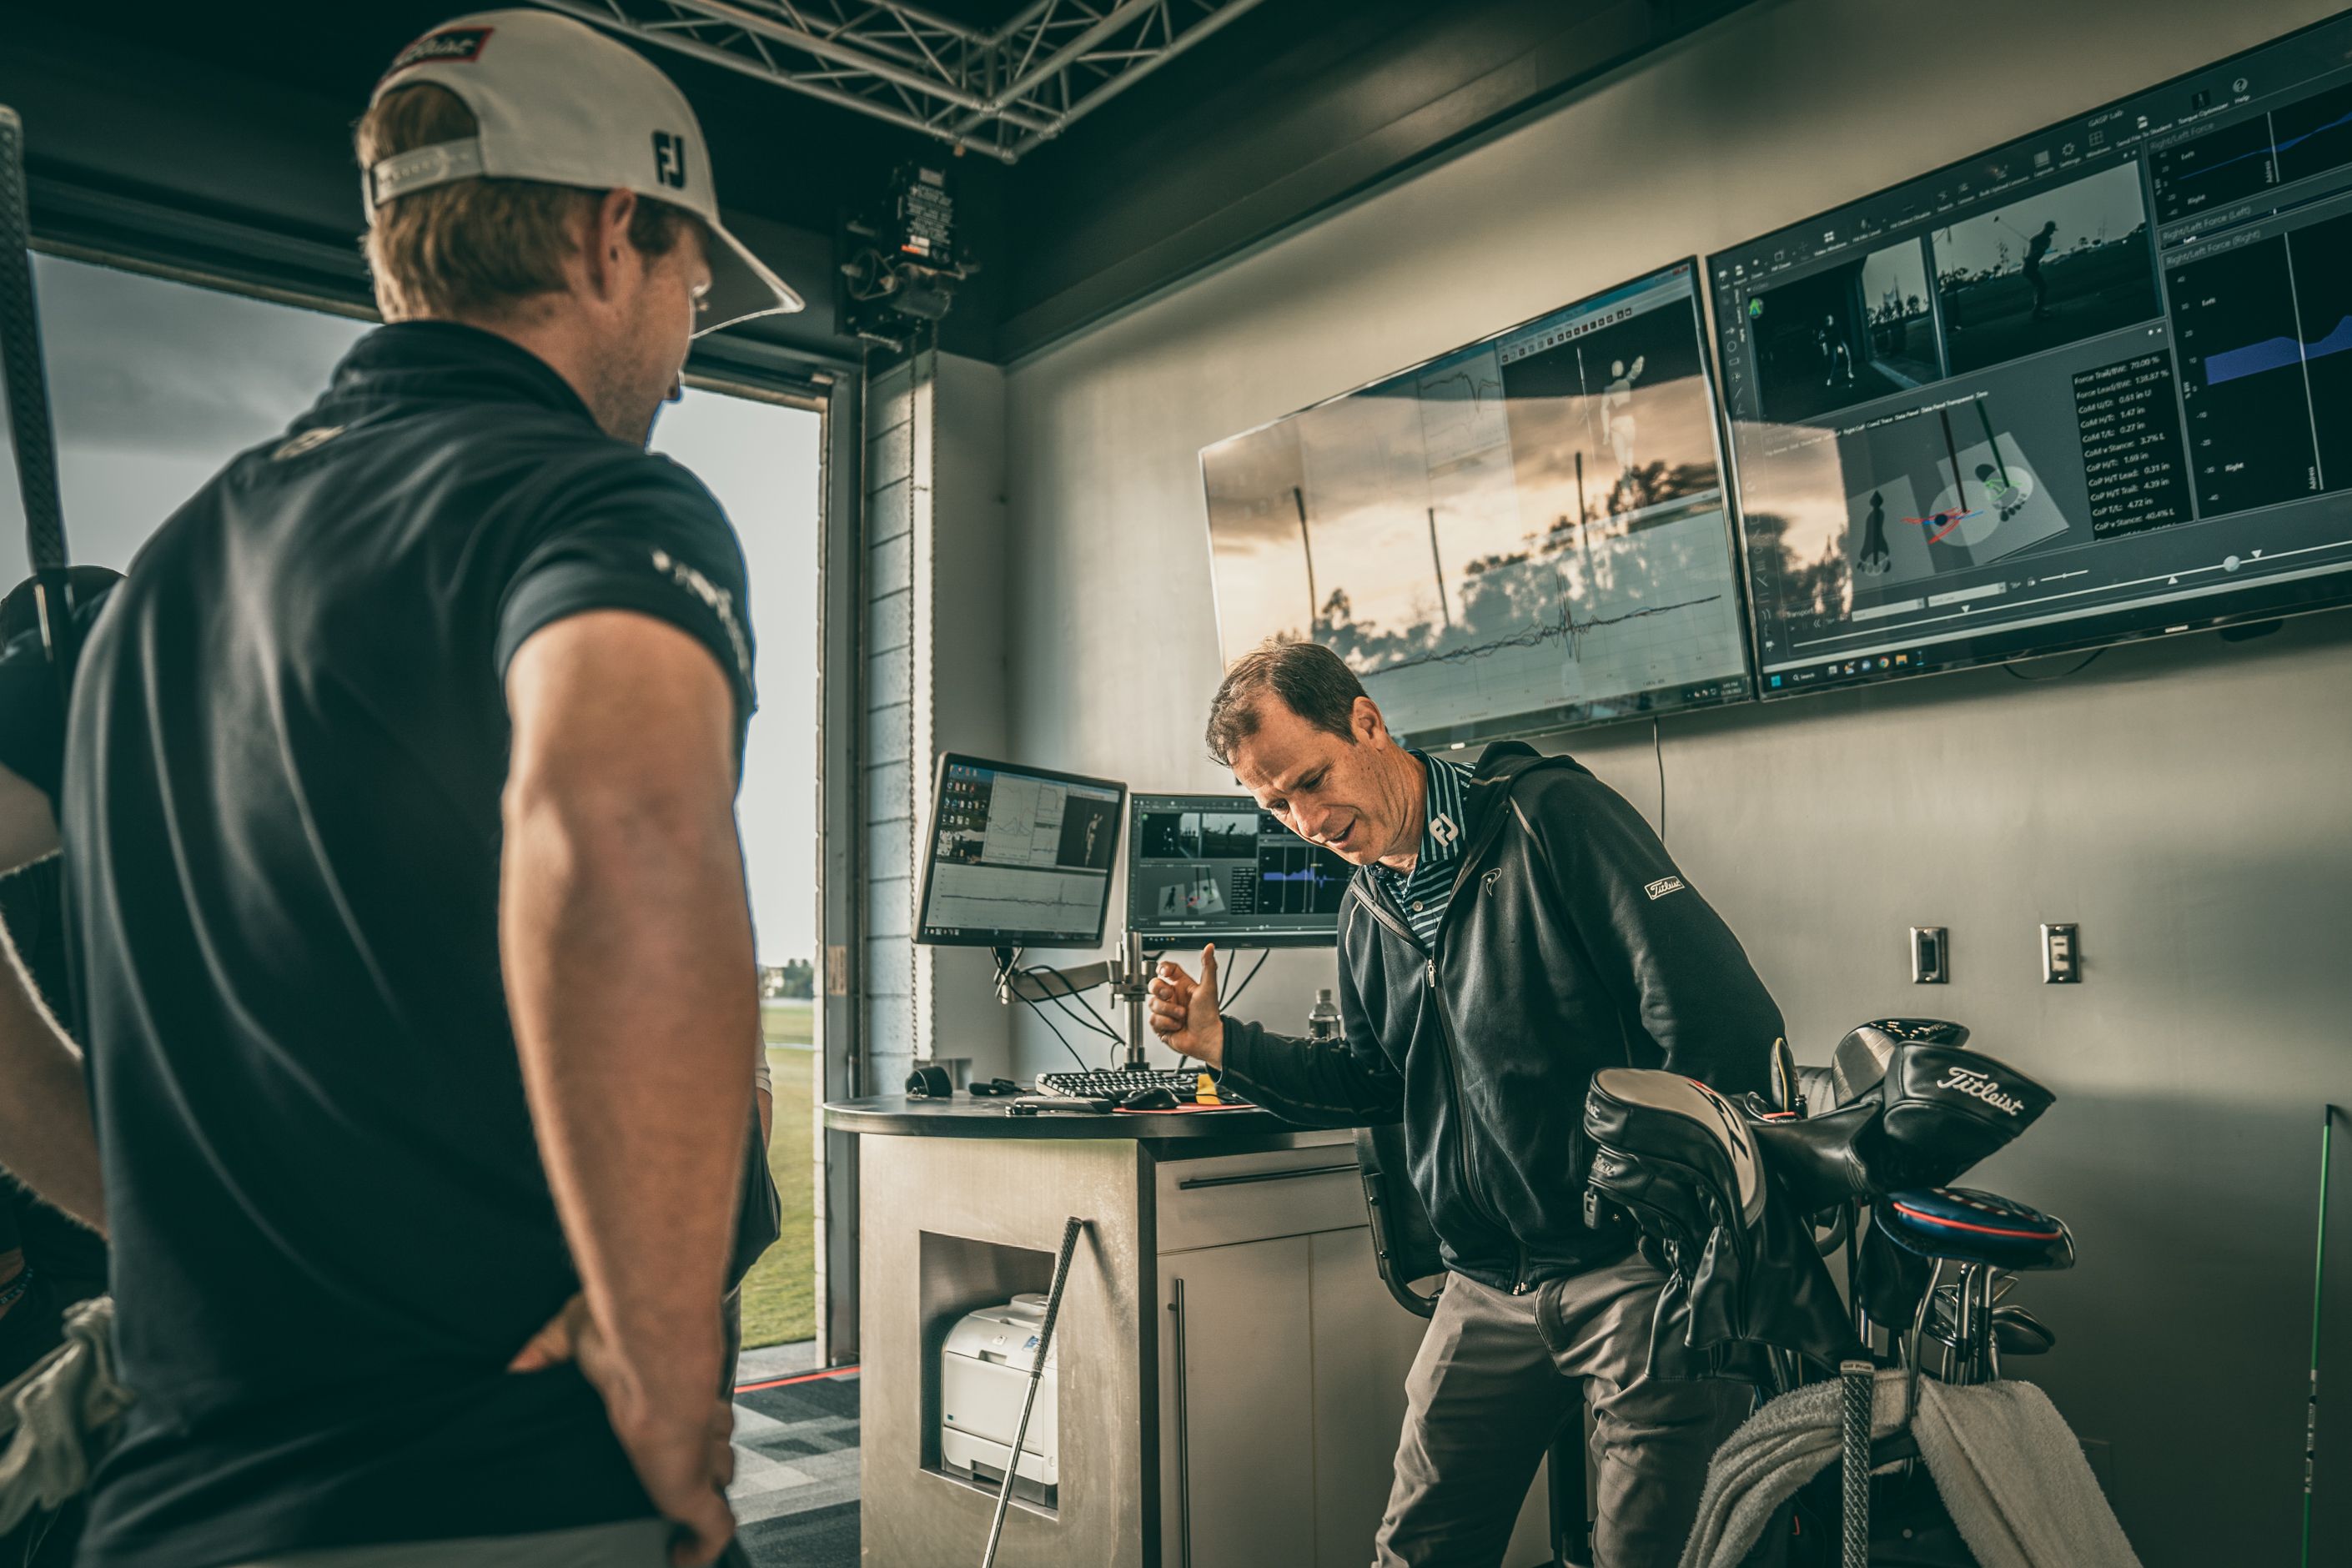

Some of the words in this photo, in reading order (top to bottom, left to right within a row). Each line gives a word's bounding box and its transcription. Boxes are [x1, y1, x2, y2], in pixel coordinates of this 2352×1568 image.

[2234, 94, 2250, 104] Help
[652, 129, 686, 190] FJ
[2163, 220, 2203, 241] Right/Left
[2204, 214, 2228, 226] Force
[2229, 206, 2251, 220] (Left)
[2166, 244, 2206, 265] Right/Left
[2208, 238, 2231, 251] Force
[2232, 229, 2261, 247] (Right)
[2202, 297, 2216, 307] Left
[2074, 374, 2094, 384] Force
[2151, 355, 2160, 364] %
[2076, 389, 2096, 400] Force
[2160, 369, 2169, 378] %
[2078, 404, 2096, 414] CoM
[2135, 391, 2144, 400] in
[2080, 418, 2098, 429] CoM
[2136, 405, 2146, 415] in
[2082, 433, 2100, 443] CoM
[2136, 421, 2146, 430] in
[2086, 462, 2101, 472] CoP
[2139, 451, 2149, 460] in
[2224, 462, 2244, 472] Right
[2088, 477, 2103, 487] CoP
[2160, 462, 2170, 470] in
[2309, 465, 2317, 490] Address
[2090, 491, 2105, 501] CoP
[2160, 477, 2169, 485] in
[2092, 507, 2108, 516] CoP
[2144, 497, 2153, 505] in
[2094, 521, 2109, 531] CoP
[1787, 606, 1814, 617] Transport
[1429, 812, 1459, 847] FJ
[1650, 881, 1681, 897] Titleist
[1937, 1067, 2024, 1116] Titleist
